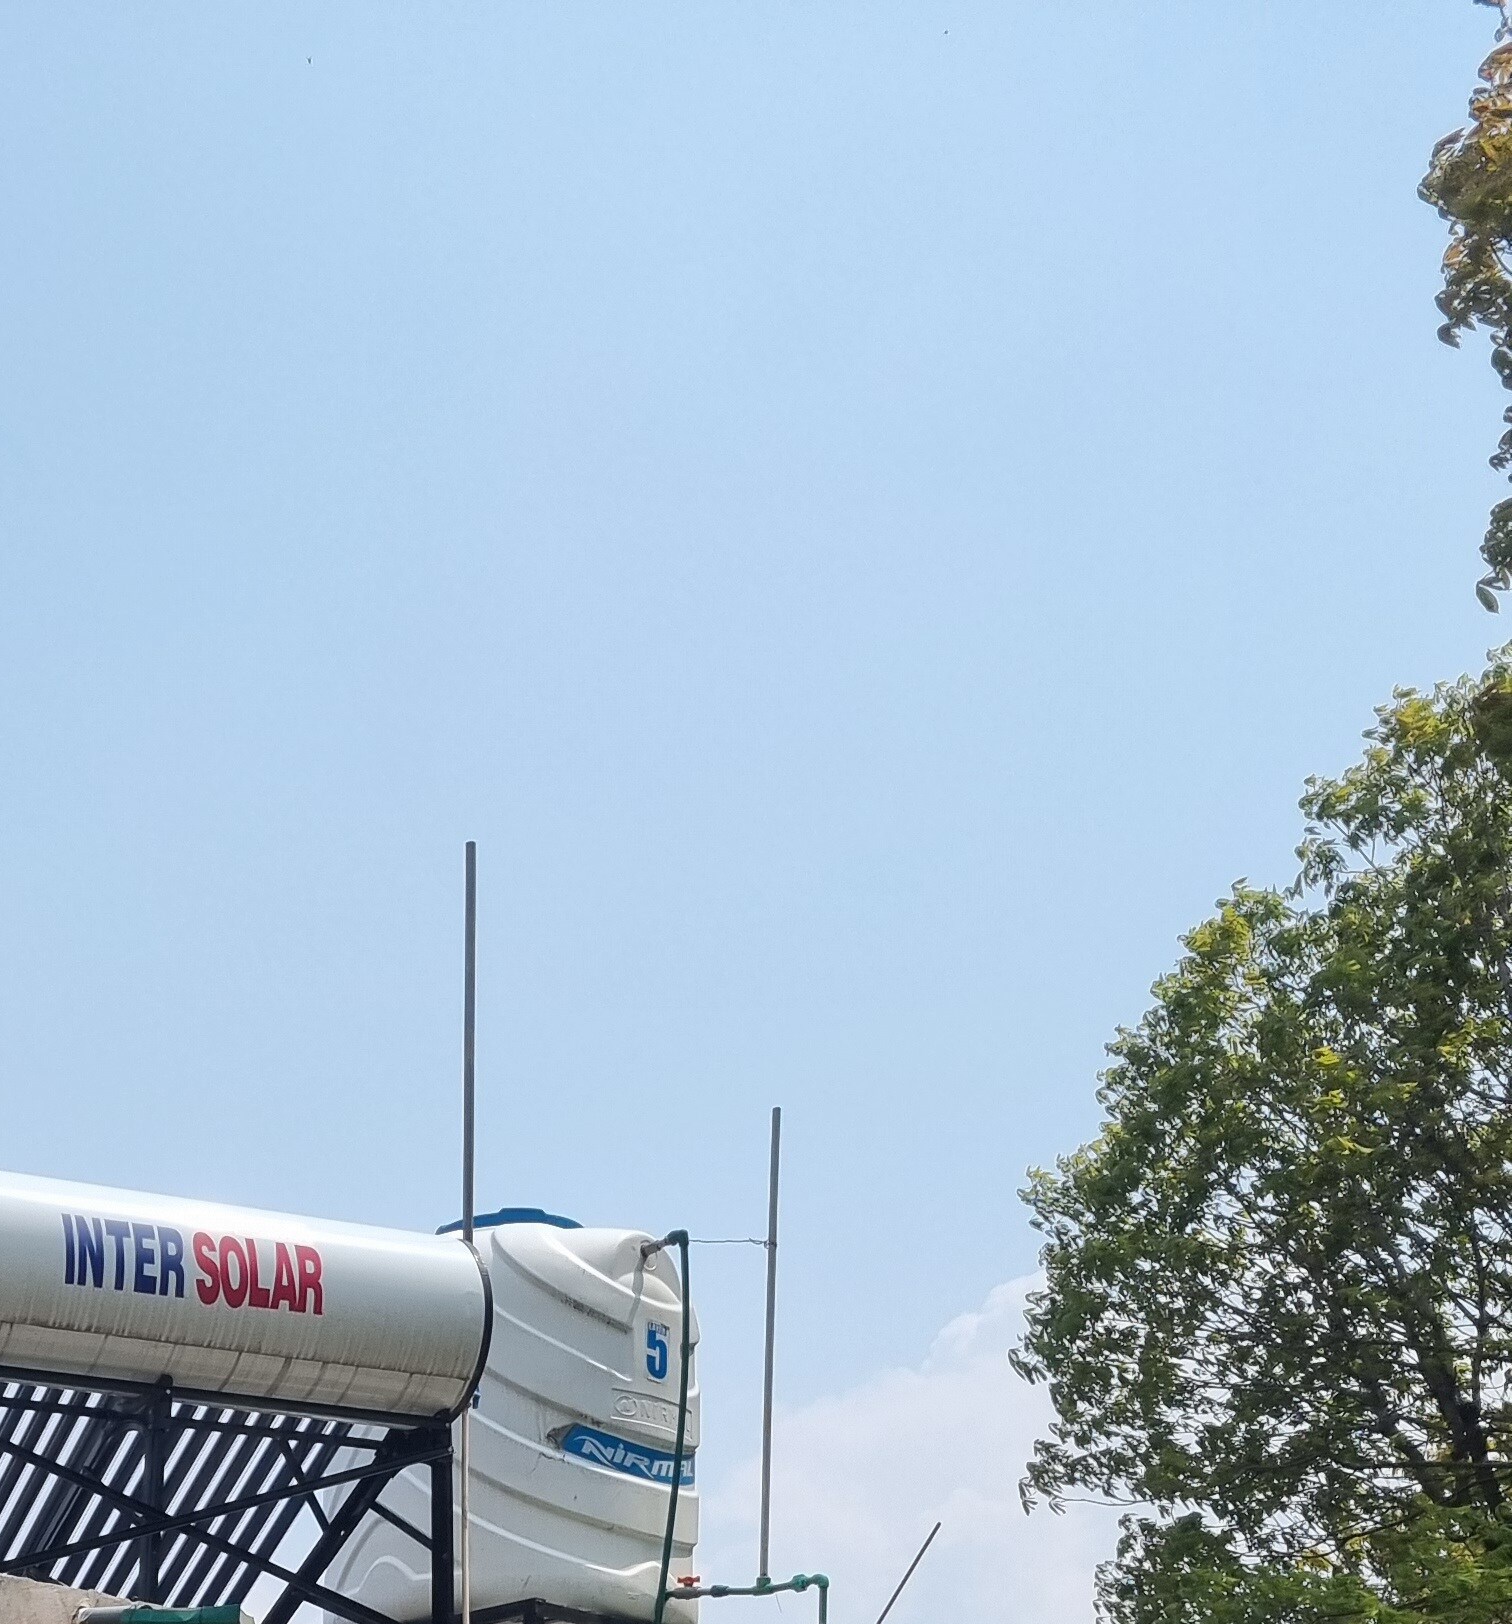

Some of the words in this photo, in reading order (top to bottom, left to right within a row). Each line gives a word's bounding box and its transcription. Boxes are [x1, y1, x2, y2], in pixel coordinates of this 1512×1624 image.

[61, 1212, 185, 1298] INTER
[192, 1231, 324, 1316] SOLAR
[646, 1329, 668, 1380] 5
